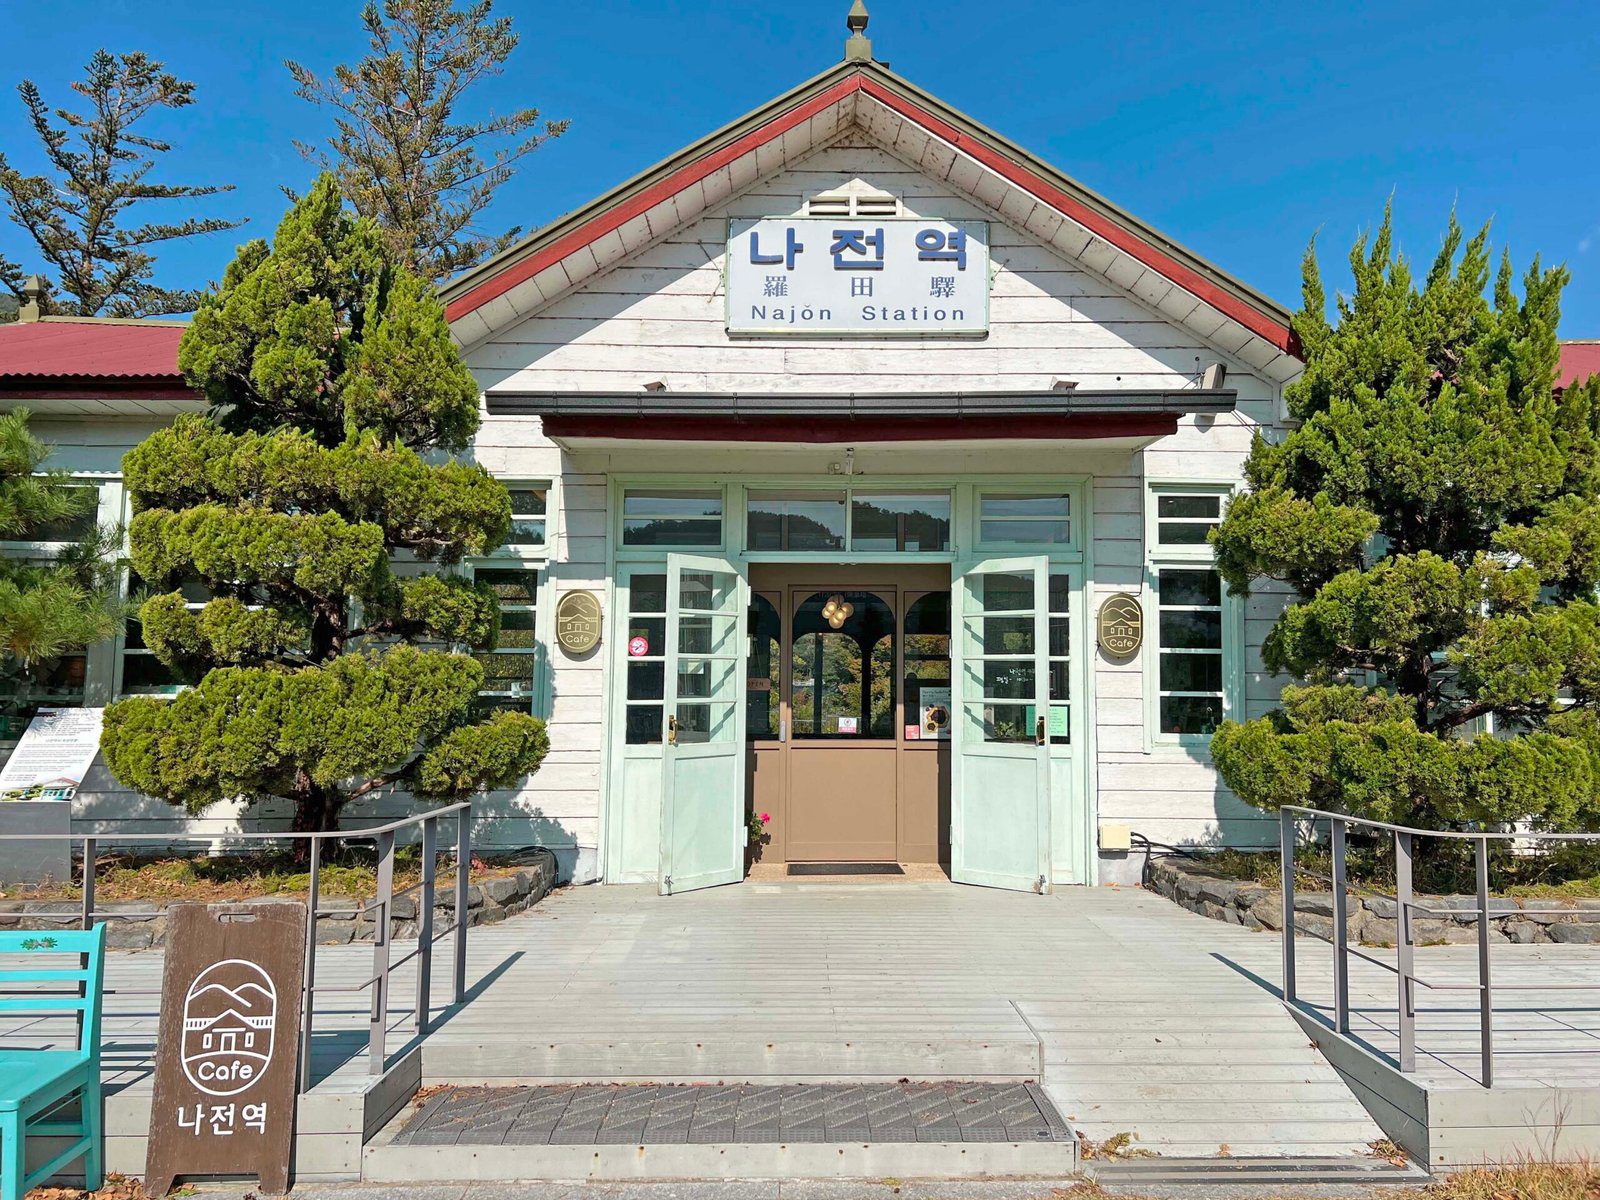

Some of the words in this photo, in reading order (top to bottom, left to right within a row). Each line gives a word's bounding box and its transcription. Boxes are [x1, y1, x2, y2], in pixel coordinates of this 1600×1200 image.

[750, 228, 967, 271] 나전역
[862, 306, 964, 321] Station
[566, 635, 589, 643] Cafe
[1109, 639, 1133, 648] Cafe
[198, 1060, 253, 1081] Cafe
[178, 1103, 267, 1136] 나전역
